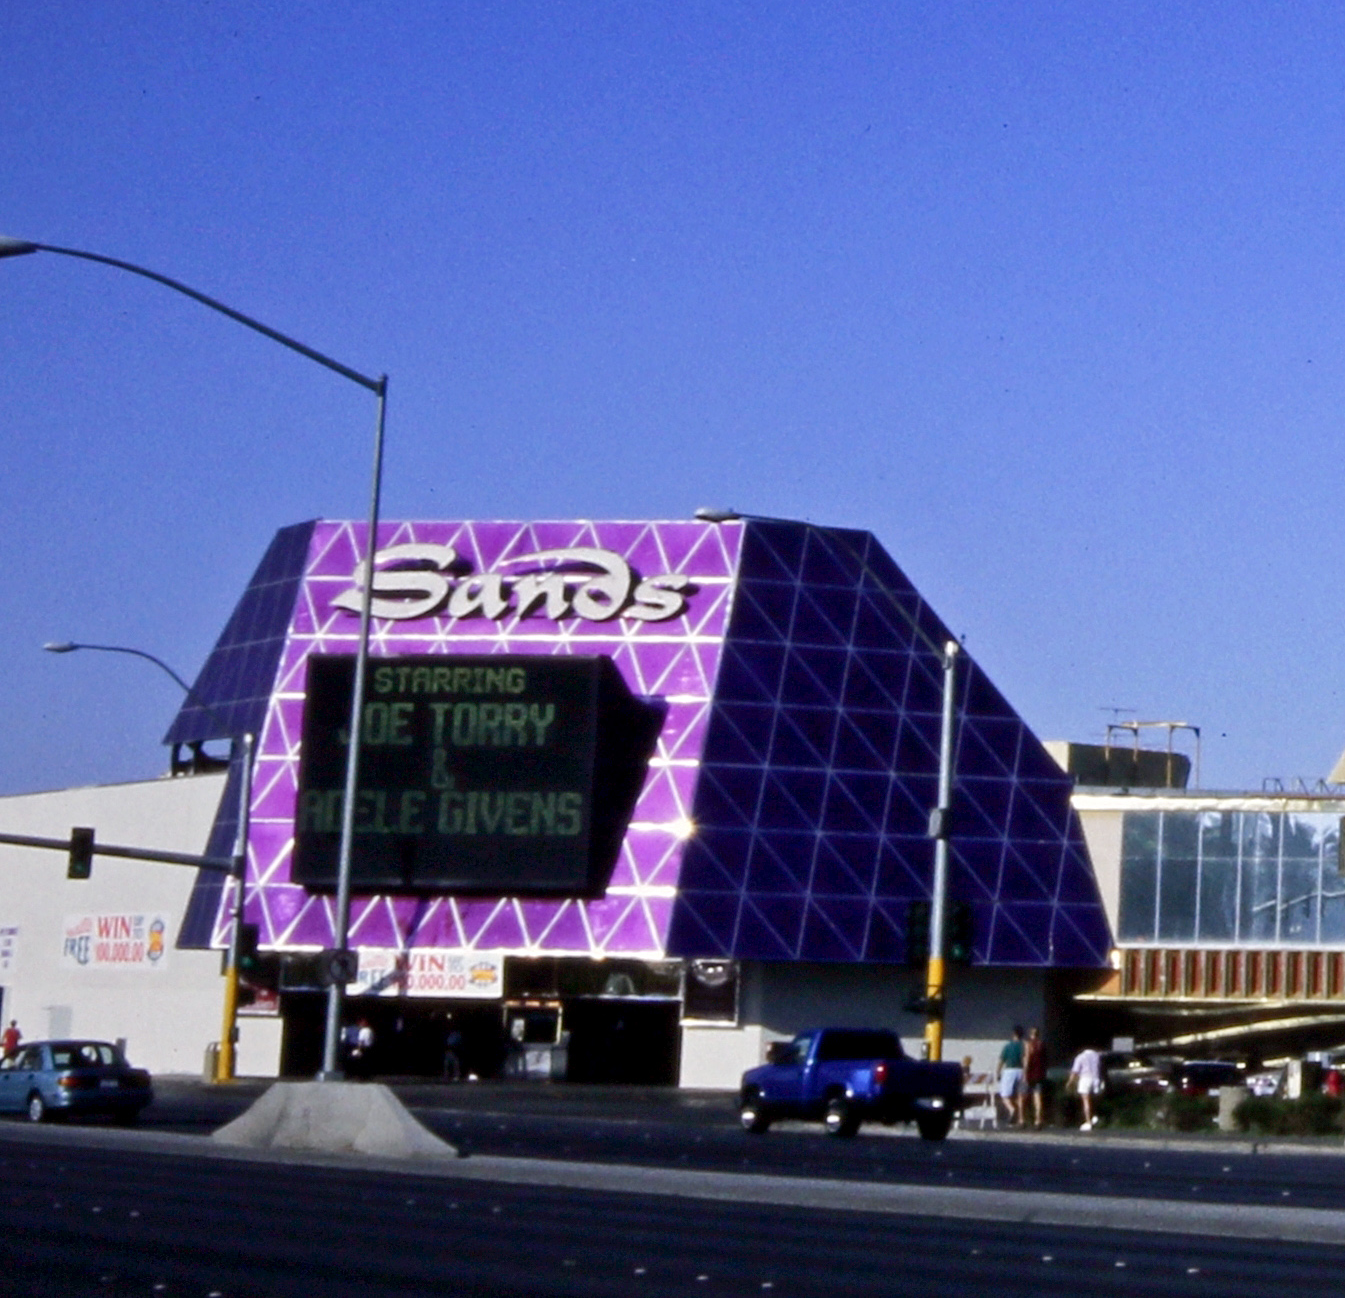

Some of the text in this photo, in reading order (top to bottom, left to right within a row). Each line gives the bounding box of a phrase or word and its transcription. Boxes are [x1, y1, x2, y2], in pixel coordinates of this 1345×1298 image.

[329, 543, 688, 620] Sands
[374, 667, 526, 693] STARRING
[429, 703, 555, 746] TORRY
[431, 748, 455, 789] &
[437, 792, 583, 836] GIVENS
[98, 916, 131, 939] WIN
